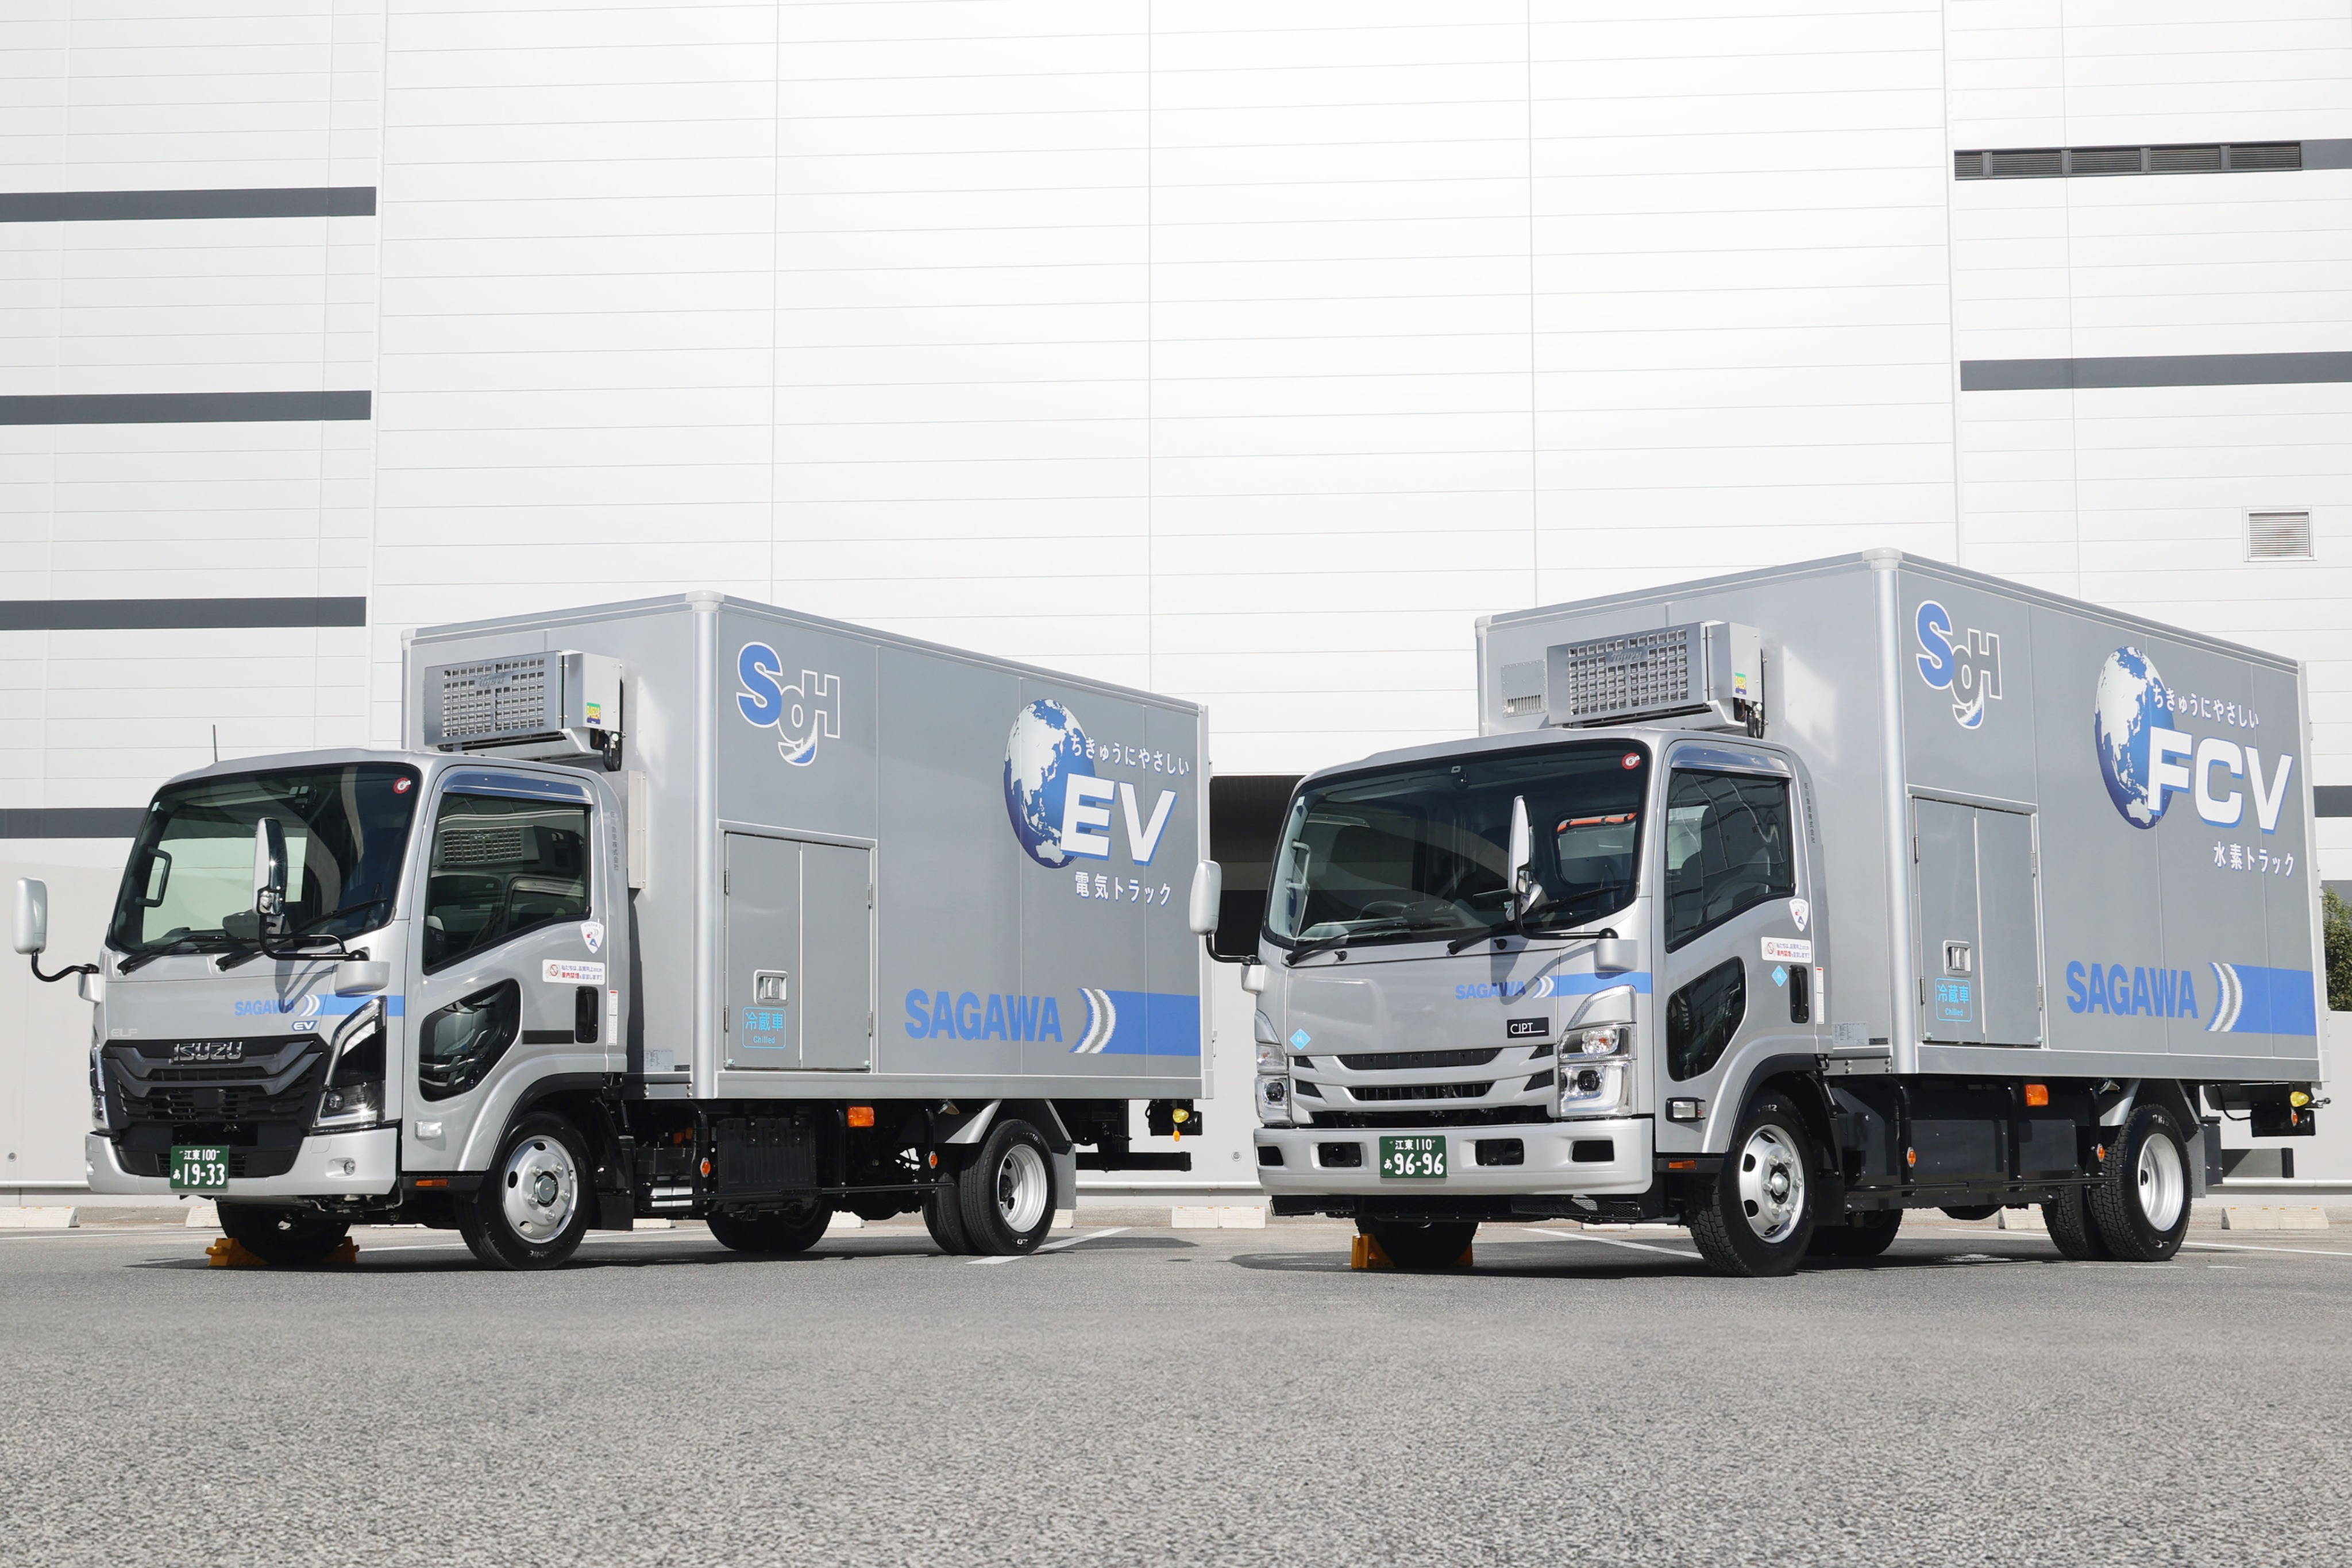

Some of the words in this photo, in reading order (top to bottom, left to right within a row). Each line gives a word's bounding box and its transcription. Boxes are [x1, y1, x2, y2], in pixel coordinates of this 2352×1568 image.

[2153, 685, 2259, 729] ちきゅうにやさしい
[1070, 735, 1189, 775] ちきゅうにやさしい
[2147, 726, 2293, 835] FCV
[1061, 773, 1177, 866] EV
[2213, 841, 2294, 877] 水素トラック
[1075, 871, 1171, 906] 電気トラック
[1455, 980, 1526, 1000] SAGAWA
[1937, 984, 1969, 1004] 冷蔵車
[2066, 960, 2199, 1020] SAGAWA
[234, 999, 296, 1017] SAGAWA
[904, 988, 1063, 1042] SAGAWA
[1945, 1007, 1963, 1016] Chilled
[295, 1021, 315, 1030] EV
[745, 1011, 783, 1032] 冷蔵車
[111, 1029, 138, 1037] ELF
[753, 1035, 776, 1044] Chilled
[173, 1041, 243, 1061] ISUZU
[1395, 1140, 1414, 1150] 江東
[1416, 1138, 1432, 1150] 110
[183, 1149, 201, 1160] 江東
[202, 1149, 216, 1161] 100
[1384, 1158, 1393, 1169] あ
[1394, 1153, 1444, 1175] 96-96
[173, 1169, 181, 1180] あ
[184, 1163, 225, 1185] 19-33
